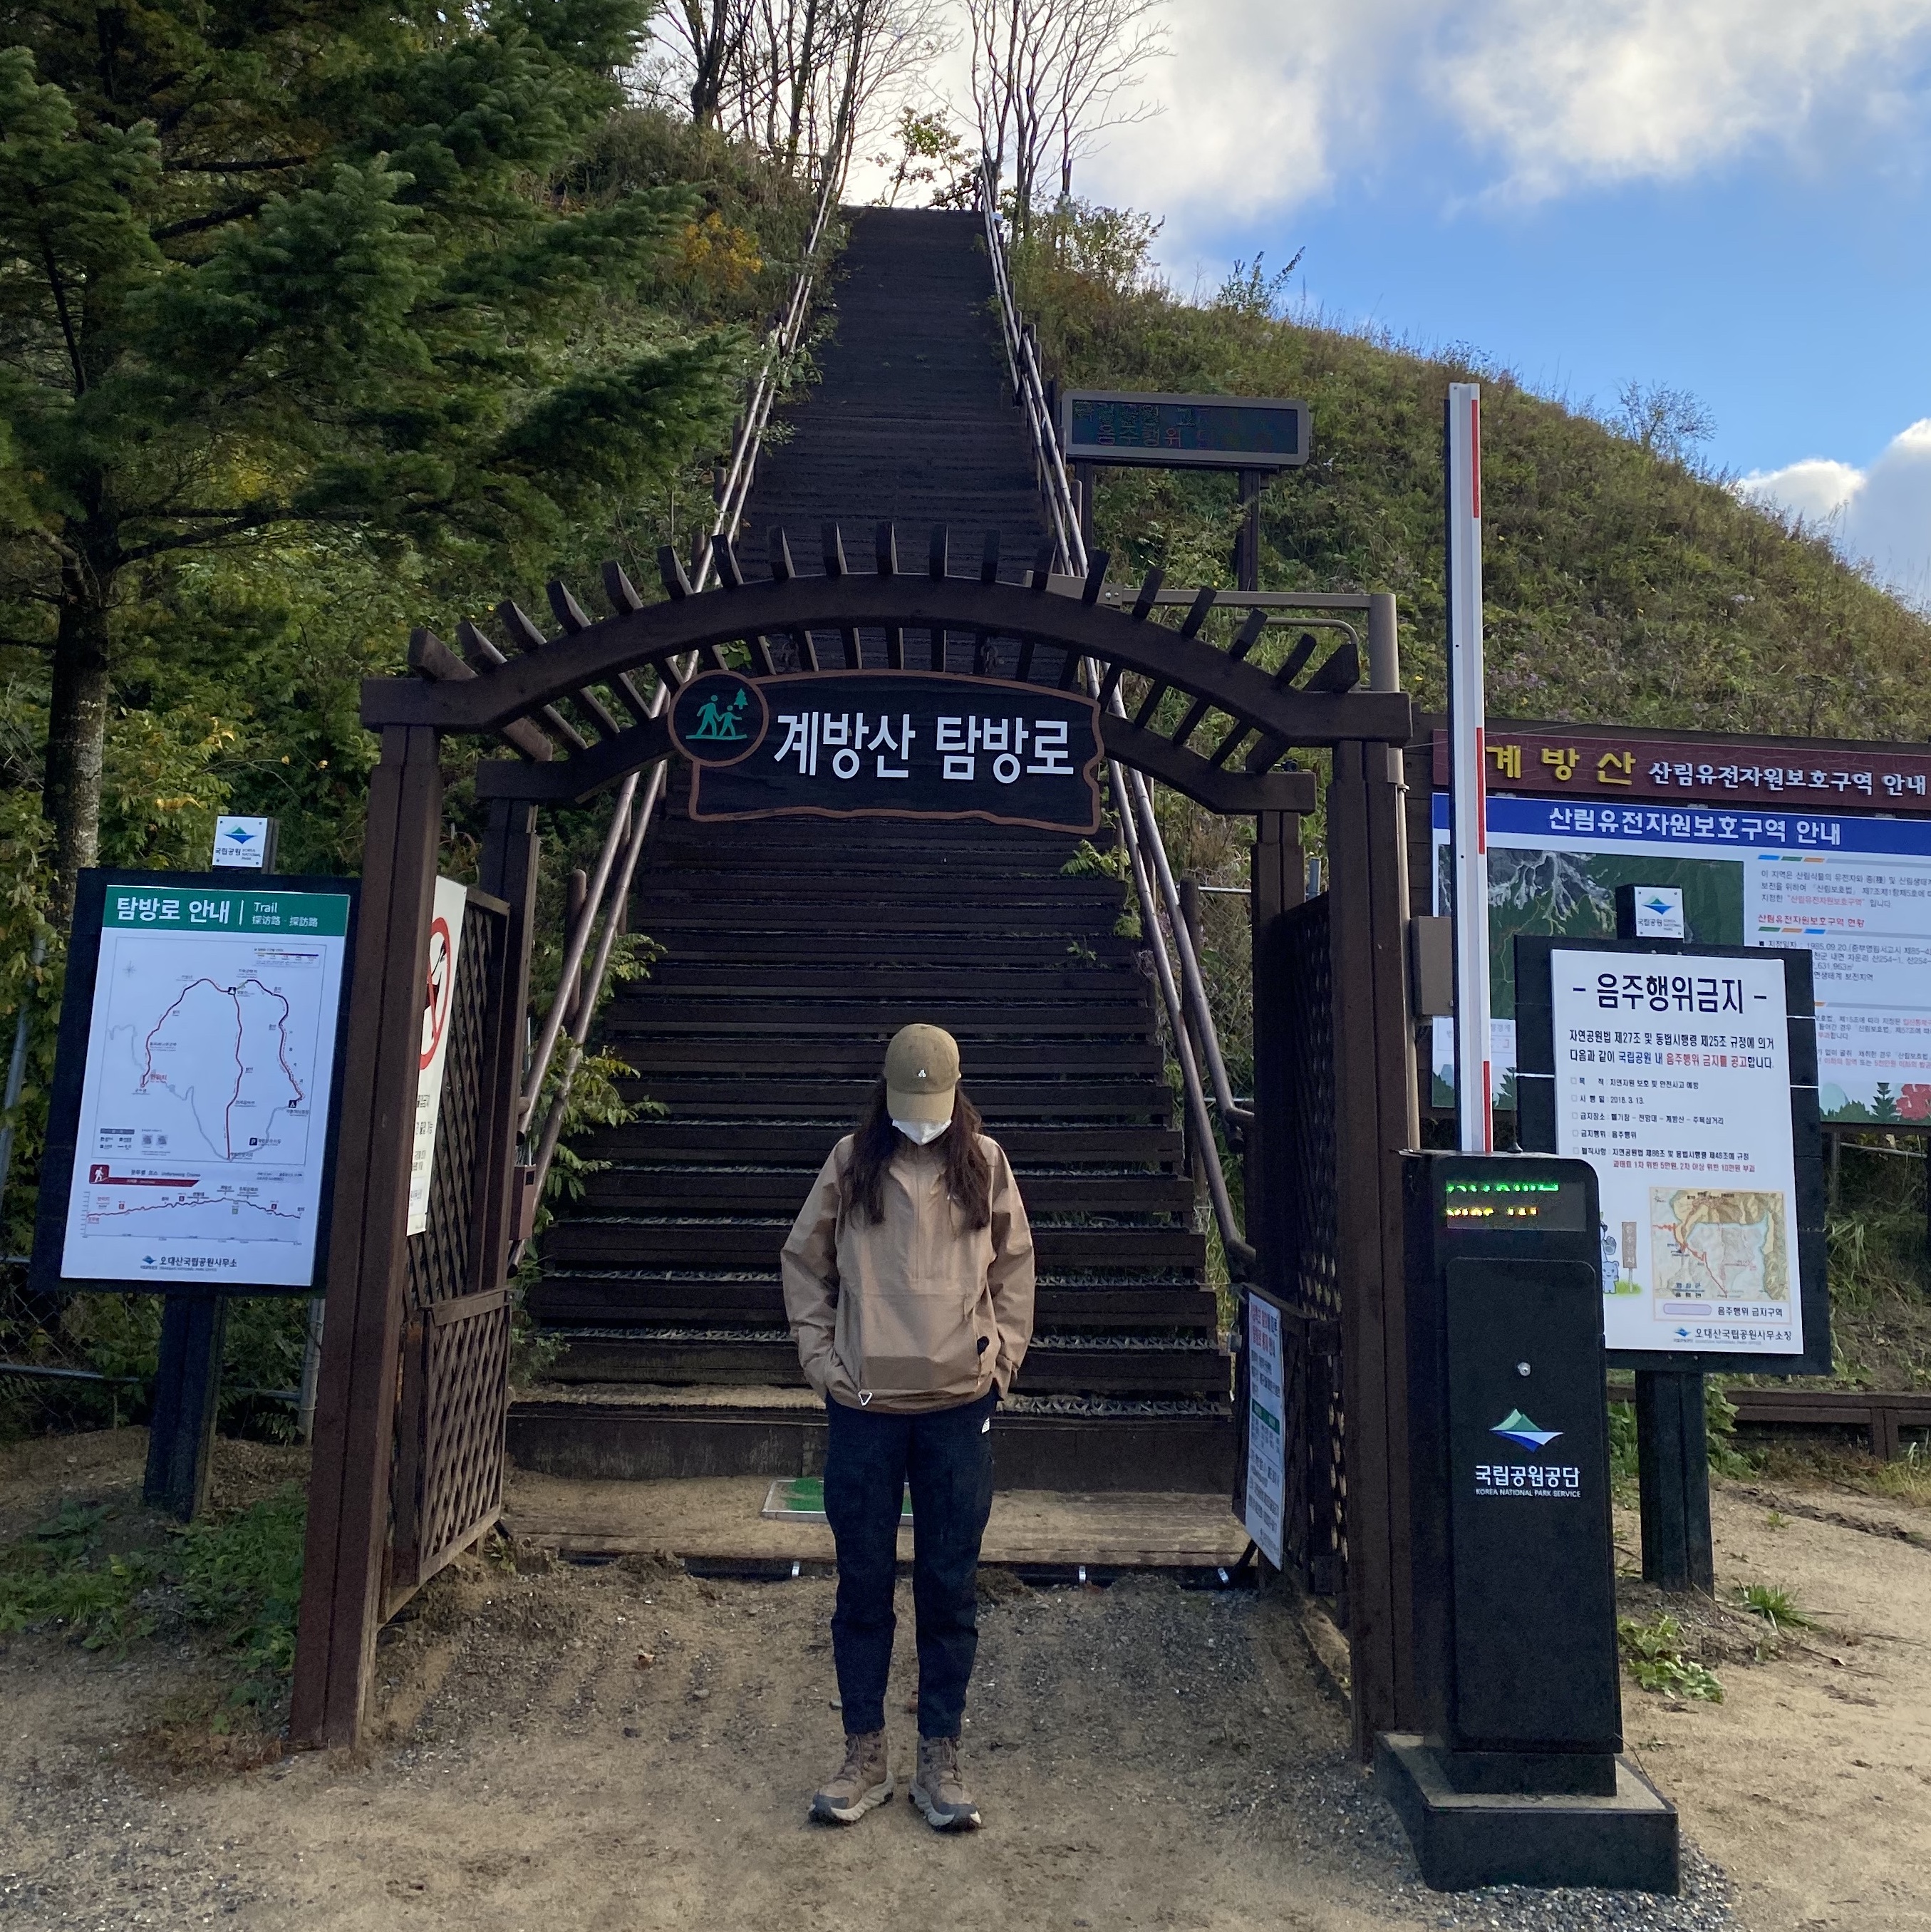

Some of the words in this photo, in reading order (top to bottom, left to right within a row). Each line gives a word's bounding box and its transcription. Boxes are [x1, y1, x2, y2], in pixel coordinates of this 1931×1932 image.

[774, 711, 916, 780] 계방산
[936, 716, 1074, 784] 탐방로
[1650, 761, 1873, 796] 산림유전자원보호구역
[1882, 773, 1926, 797] 안내
[1549, 806, 1786, 844] 산림유전자원보호구역
[1796, 820, 1841, 846] 안내
[117, 897, 180, 921] 탐방로
[189, 900, 230, 924] 안내
[254, 902, 278, 913] Trail
[1758, 914, 1845, 926] 산림유전자원보호구역
[1848, 918, 1865, 927] 현황
[1597, 973, 1744, 1015] 음주행위금지
[1570, 1029, 1611, 1043] 자연공원법
[1615, 1032, 1641, 1044] 제27조
[1645, 1033, 1652, 1045] 및
[1656, 1033, 1697, 1047] 동법시행령
[1701, 1035, 1726, 1048] 제25조
[1730, 1036, 1754, 1049] 규정에
[1758, 1037, 1774, 1050] 의거
[1570, 1049, 1595, 1062] 다음과
[1598, 1050, 1615, 1063] 같이
[1618, 1051, 1652, 1064] 국립공원
[1655, 1053, 1663, 1065] 내
[1667, 1053, 1699, 1066] 음주행위
[160, 1256, 237, 1267] 오대산국립공원사무소
[1718, 1306, 1749, 1316] 음주행위
[1695, 1328, 1791, 1340] 오대산국립공원사무소장
[1475, 1465, 1580, 1488] 국립공원공단
